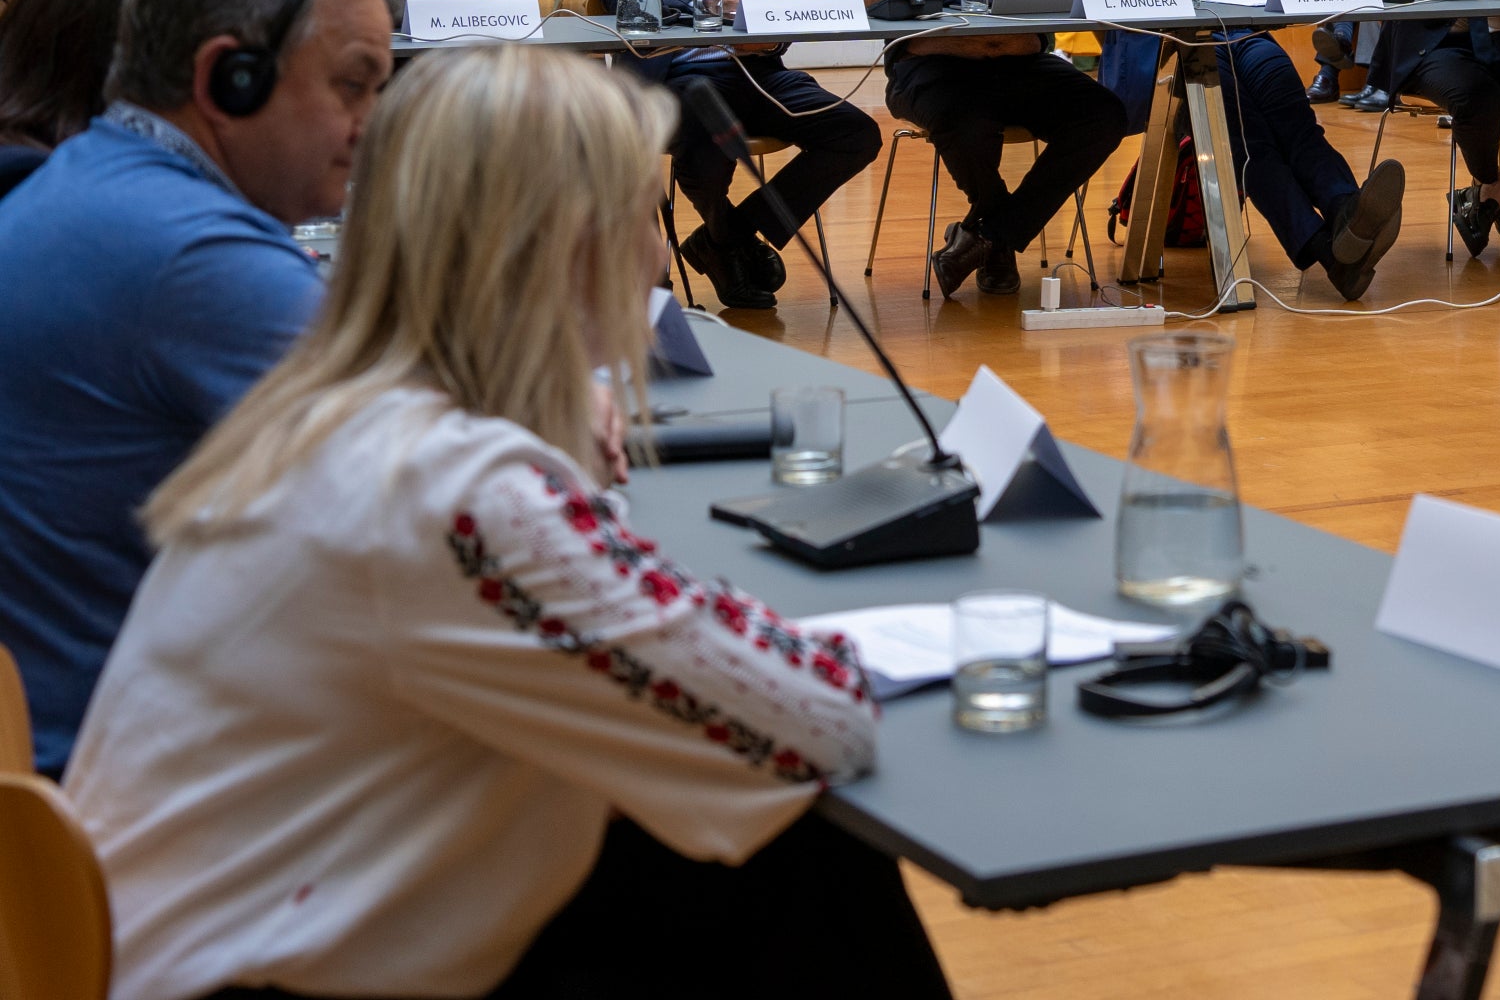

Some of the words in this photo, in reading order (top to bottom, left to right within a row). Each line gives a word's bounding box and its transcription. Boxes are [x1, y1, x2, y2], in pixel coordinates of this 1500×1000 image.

[430, 16, 446, 29] M.
[451, 14, 529, 28] ALIBEGOVIC
[764, 10, 780, 22] G.
[784, 9, 855, 22] SAMBUCINI
